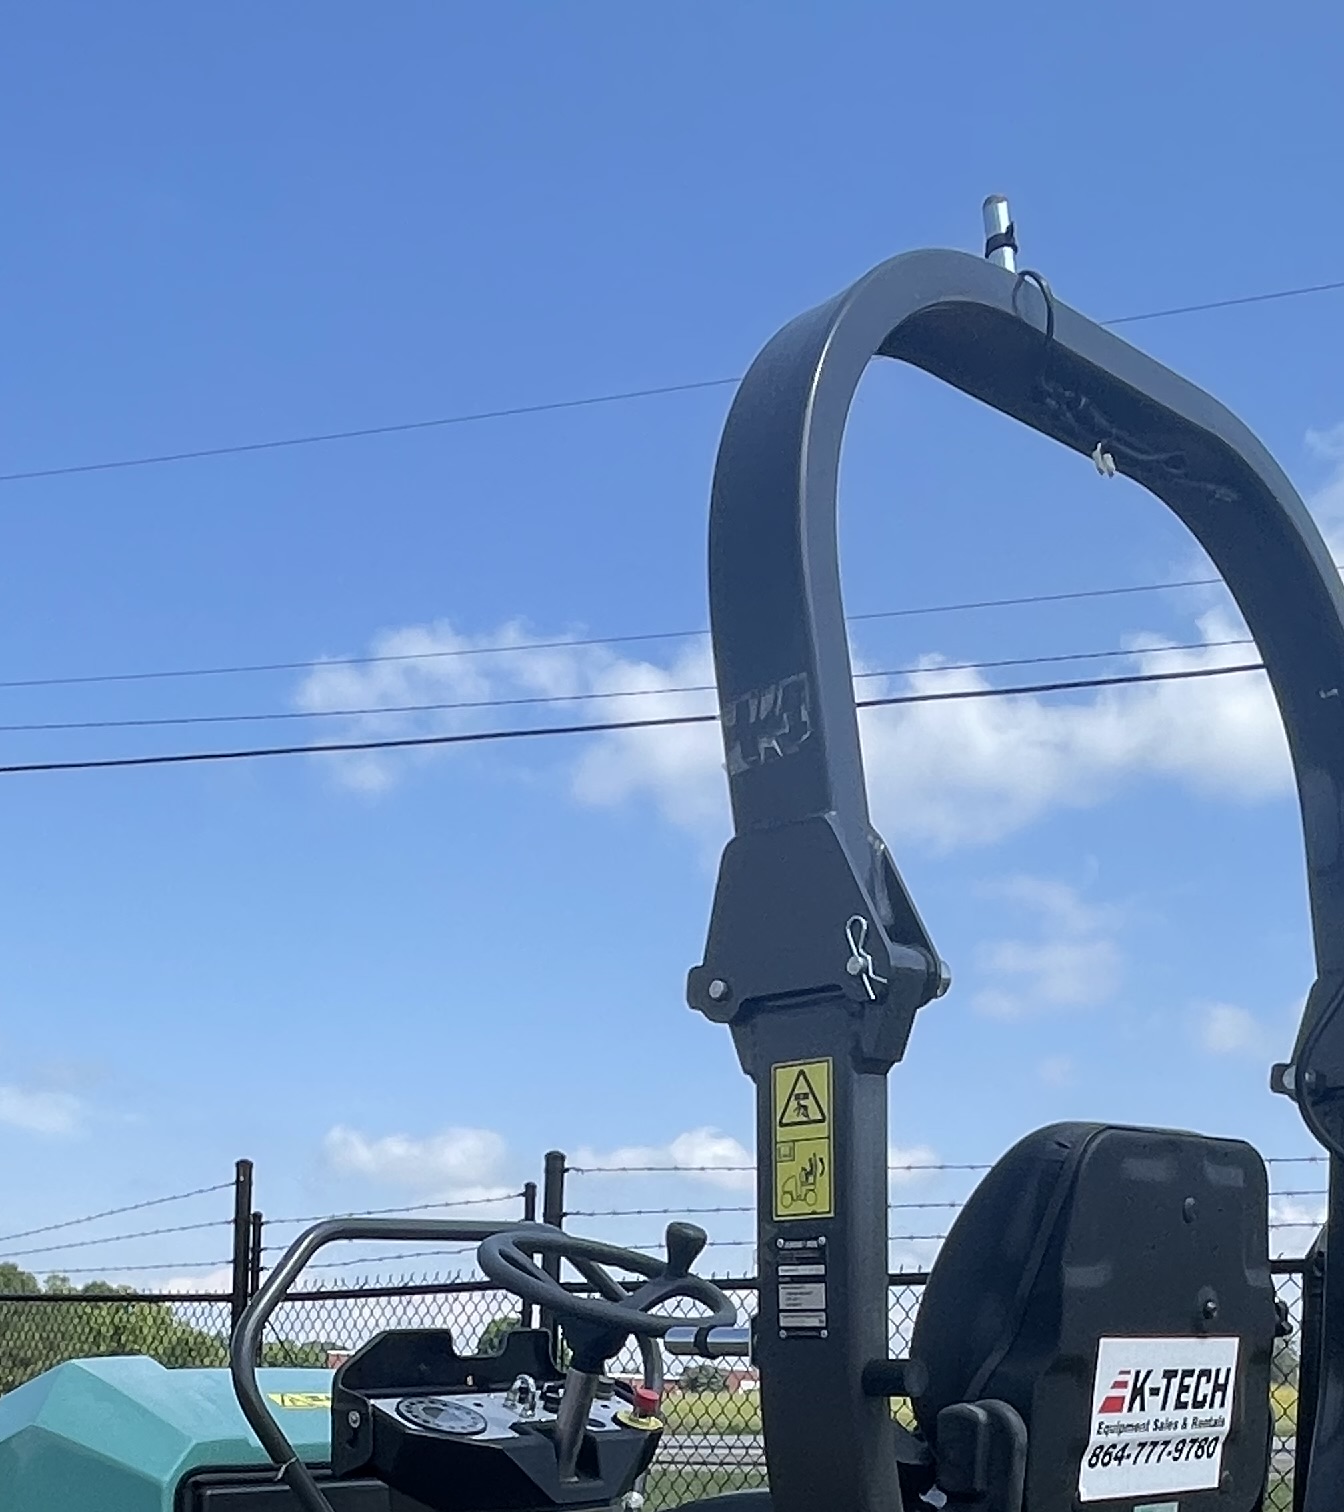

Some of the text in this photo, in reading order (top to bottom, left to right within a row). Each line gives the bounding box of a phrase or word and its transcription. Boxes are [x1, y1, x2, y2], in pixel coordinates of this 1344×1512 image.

[1097, 1415, 1226, 1437] Equipment Sales & Rentals
